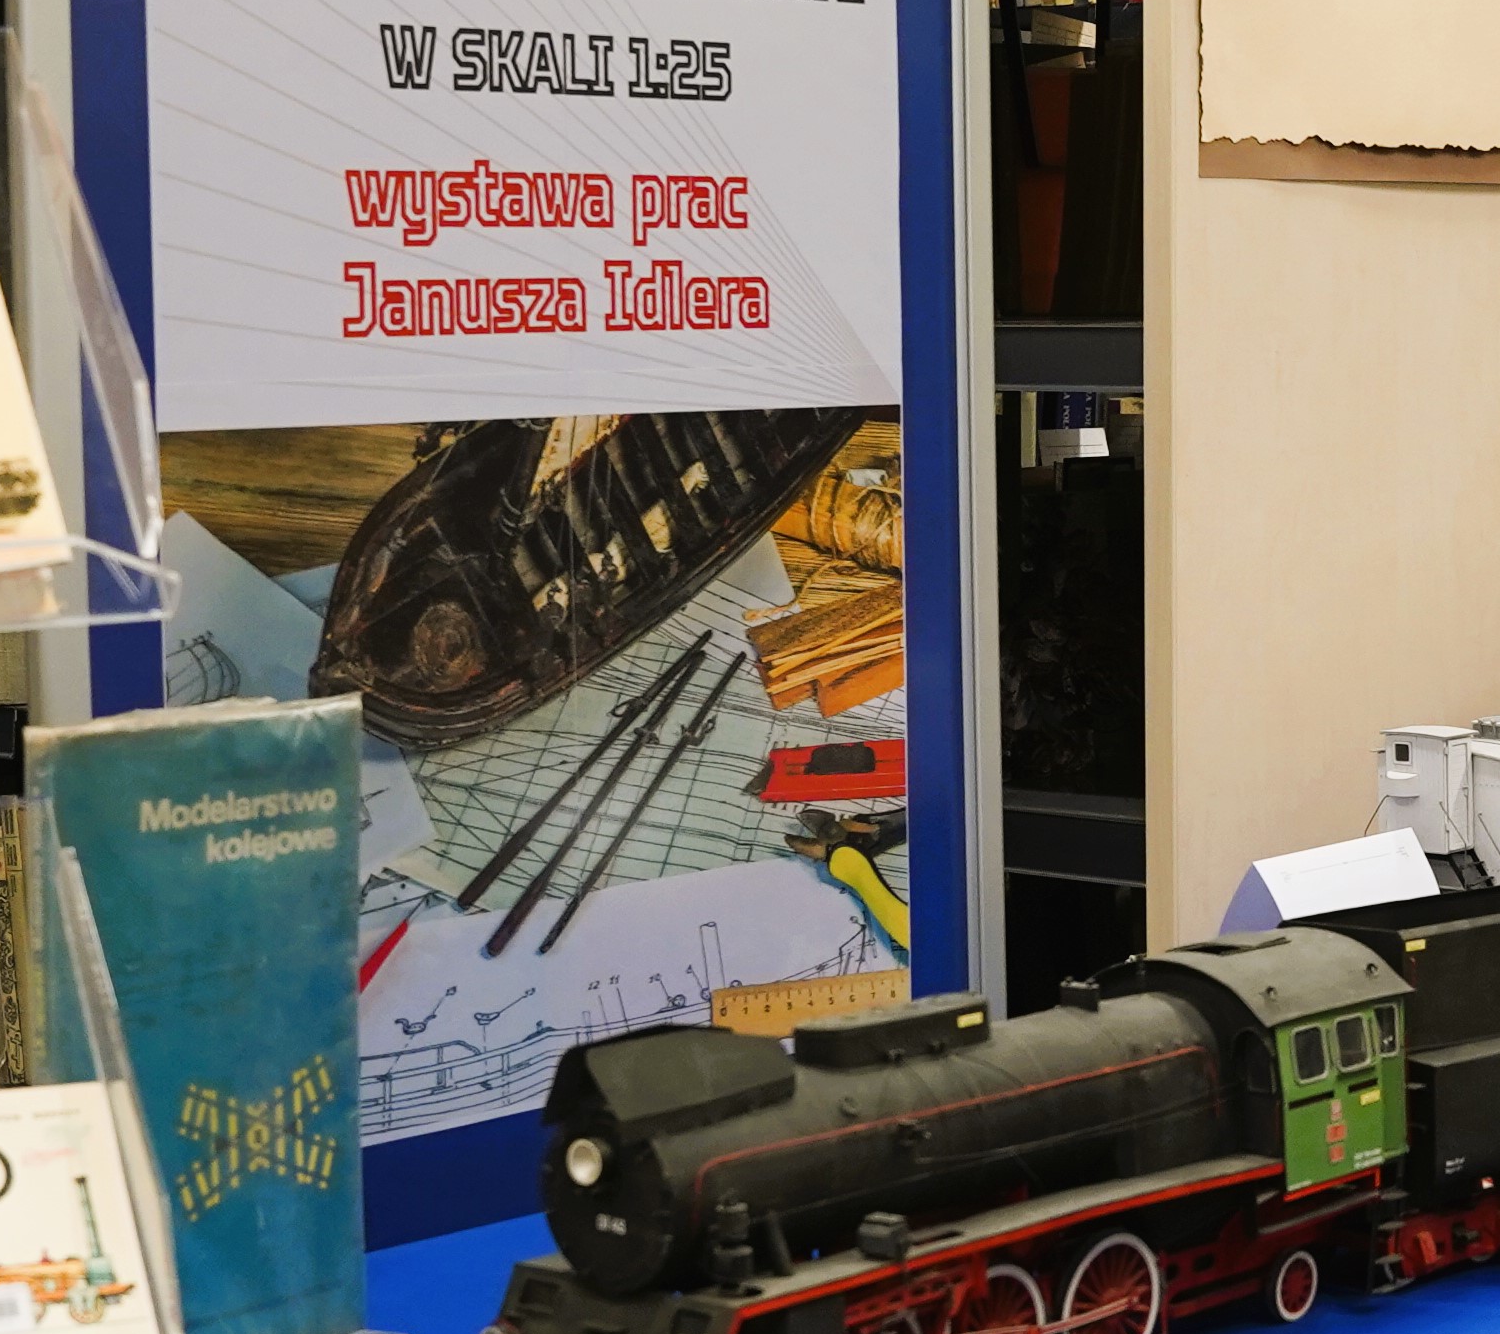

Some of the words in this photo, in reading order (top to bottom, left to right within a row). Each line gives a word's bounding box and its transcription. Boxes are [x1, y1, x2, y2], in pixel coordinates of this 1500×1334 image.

[381, 25, 434, 90] W
[453, 29, 614, 96] SKALI
[629, 38, 731, 100] 1:25
[346, 161, 612, 246] wystawa
[633, 175, 747, 245] prac
[344, 262, 586, 337] Janusza
[605, 261, 770, 331] Idlera
[140, 787, 338, 833] Modelarstwo
[206, 825, 338, 864] kolejowe
